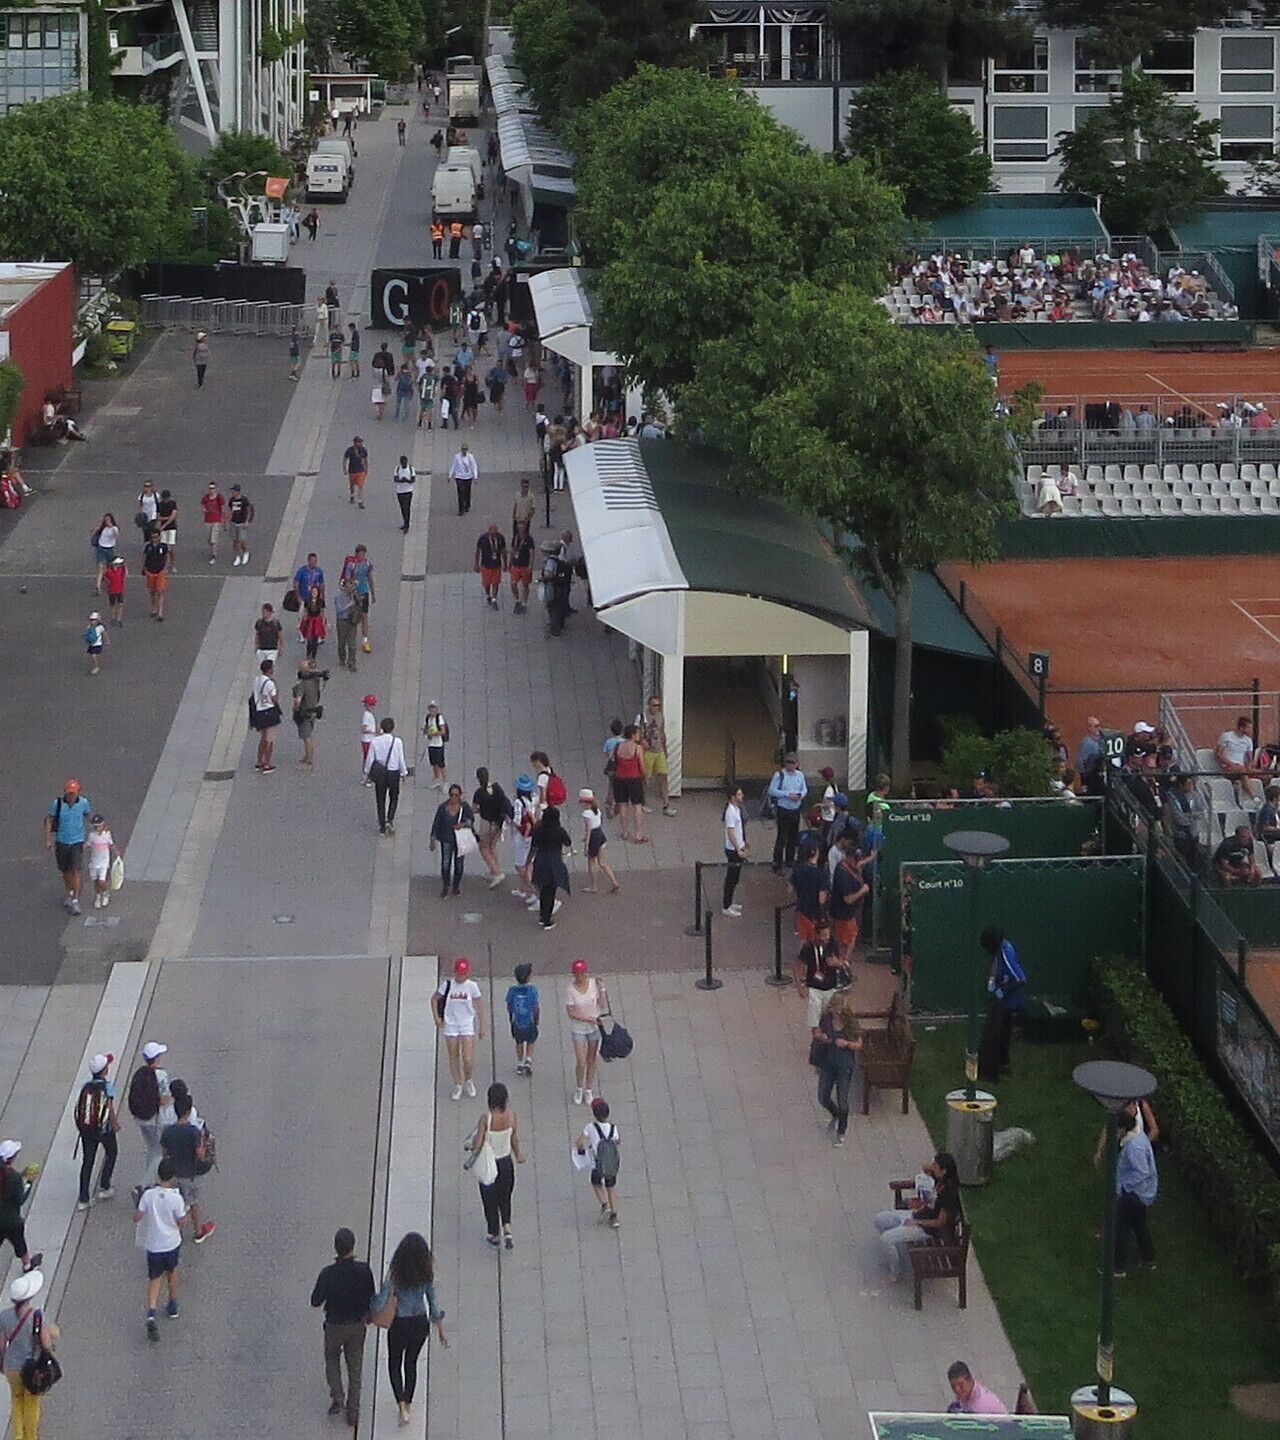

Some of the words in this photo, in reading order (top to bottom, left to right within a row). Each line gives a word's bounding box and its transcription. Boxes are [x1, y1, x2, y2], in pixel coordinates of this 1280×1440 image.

[382, 278, 409, 326] G
[1033, 657, 1044, 674] 8
[1106, 736, 1124, 756] 10
[888, 813, 911, 822] Court
[918, 880, 943, 890] Court
